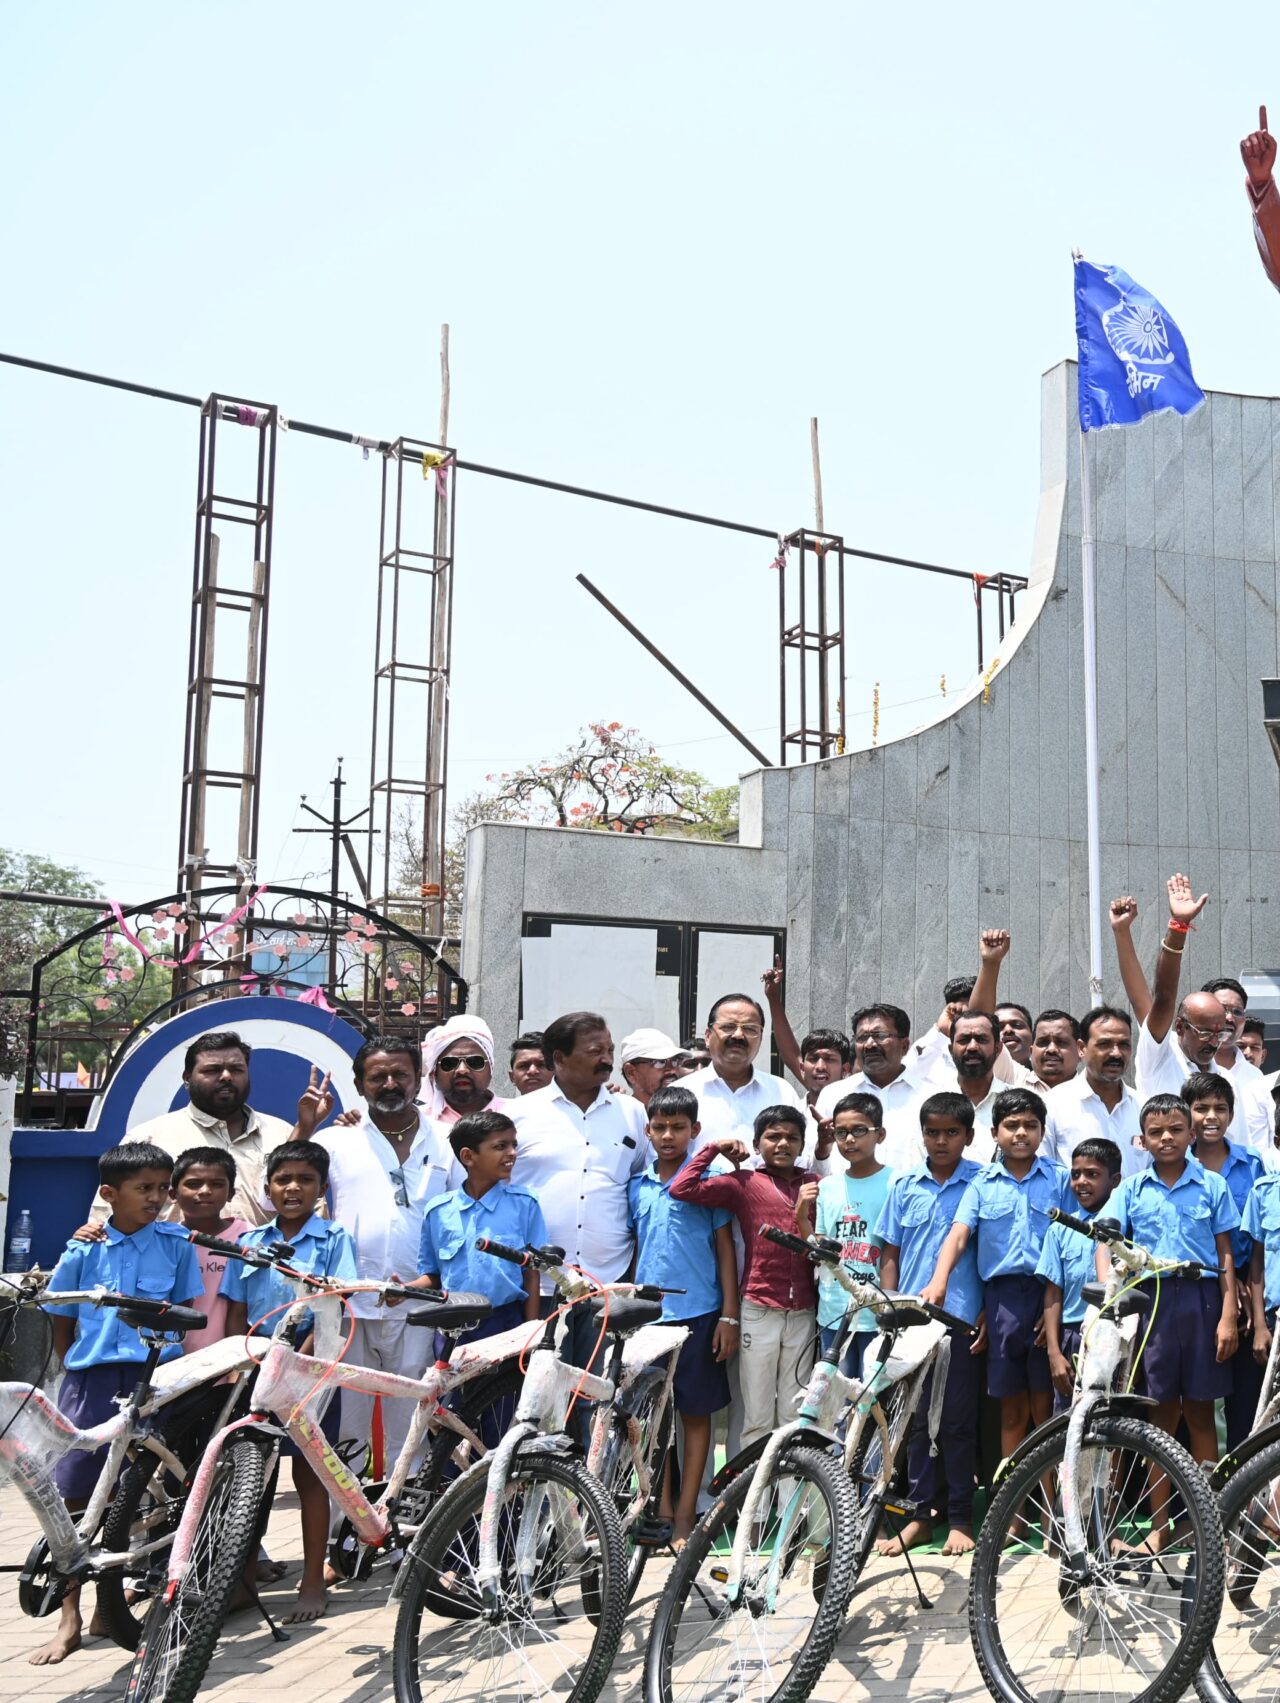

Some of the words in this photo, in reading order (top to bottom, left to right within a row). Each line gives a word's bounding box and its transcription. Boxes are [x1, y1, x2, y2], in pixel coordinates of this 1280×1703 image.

[835, 1220, 868, 1239] FEAR
[838, 1240, 881, 1265] WER
[206, 1261, 226, 1273] Kle
